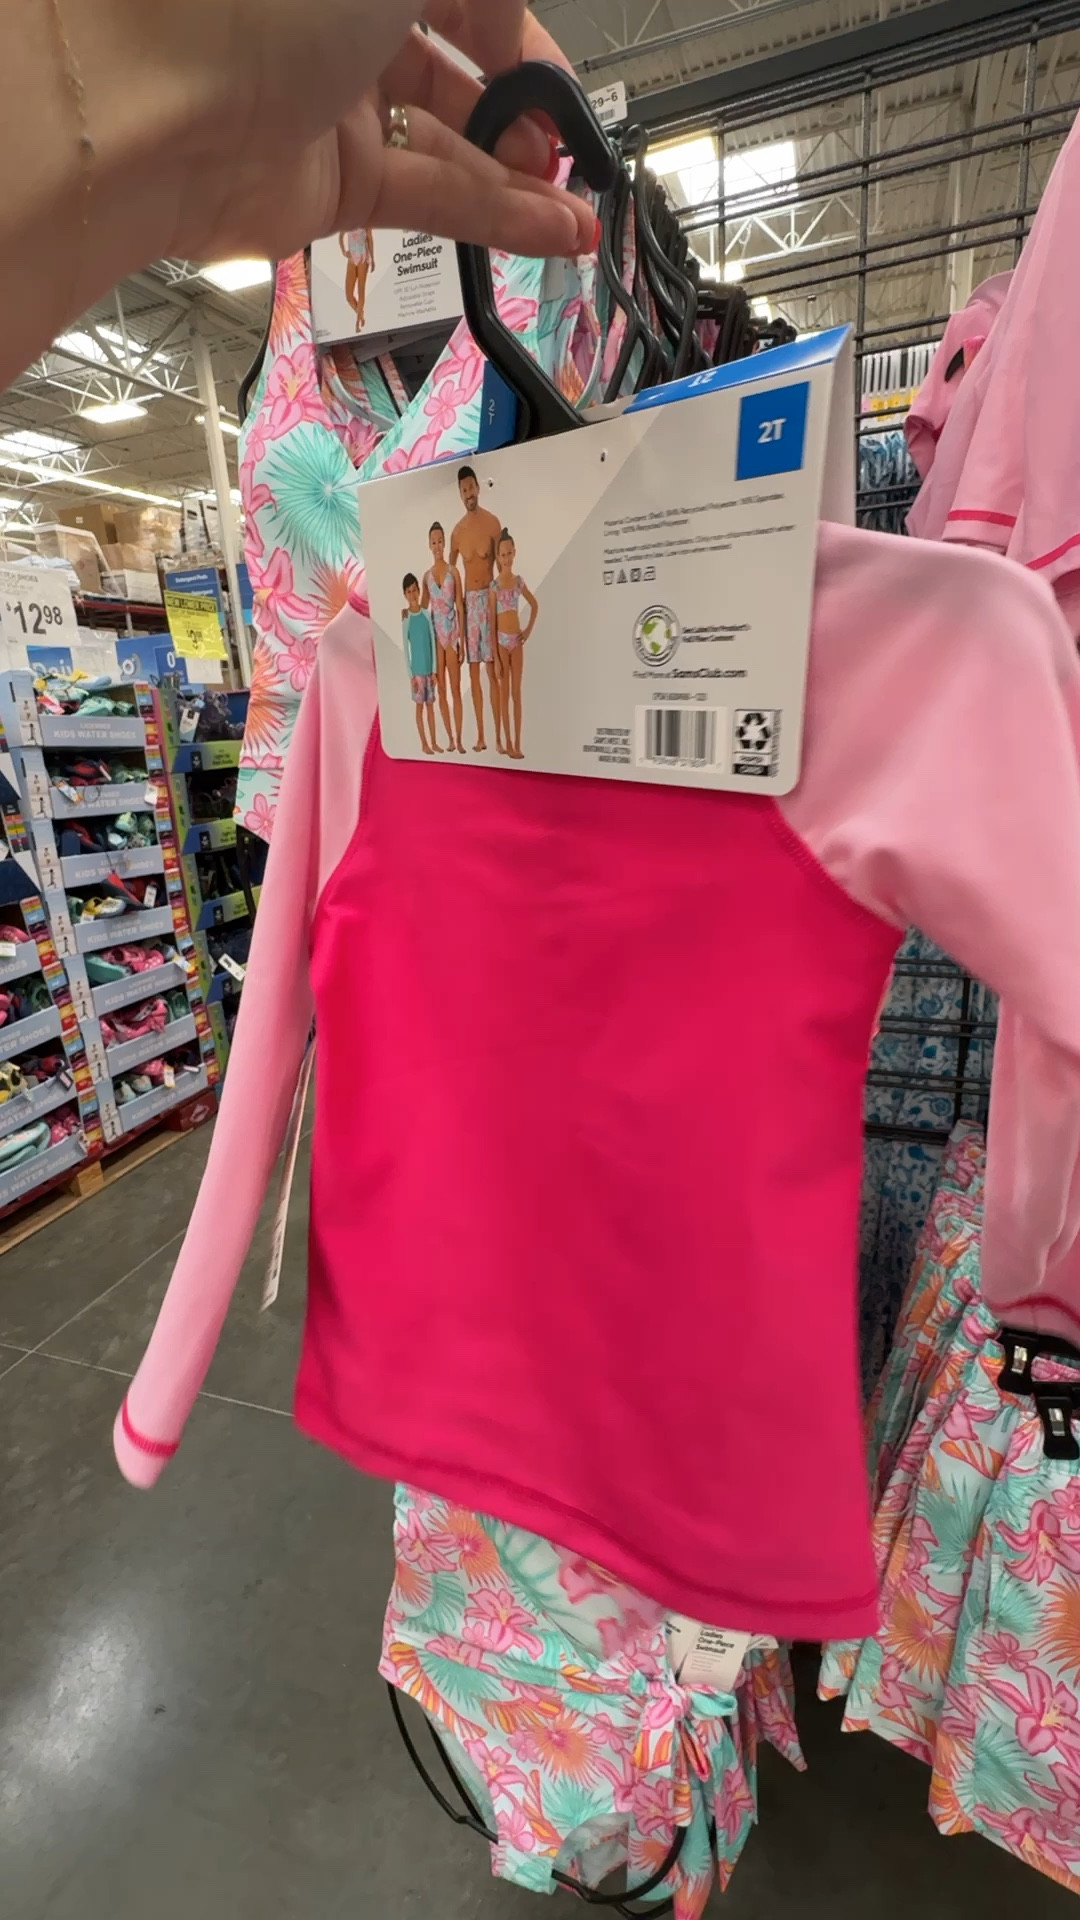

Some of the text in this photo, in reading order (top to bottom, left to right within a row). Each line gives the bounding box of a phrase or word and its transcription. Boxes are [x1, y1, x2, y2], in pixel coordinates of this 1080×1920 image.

[402, 231, 433, 248] Ladies
[393, 245, 443, 264] One-Piece
[397, 258, 438, 276] Swimsuit
[757, 417, 787, 444] 2T
[672, 668, 748, 679] SamsClub.com
[53, 730, 76, 739] KIDS
[78, 730, 107, 739] WATER
